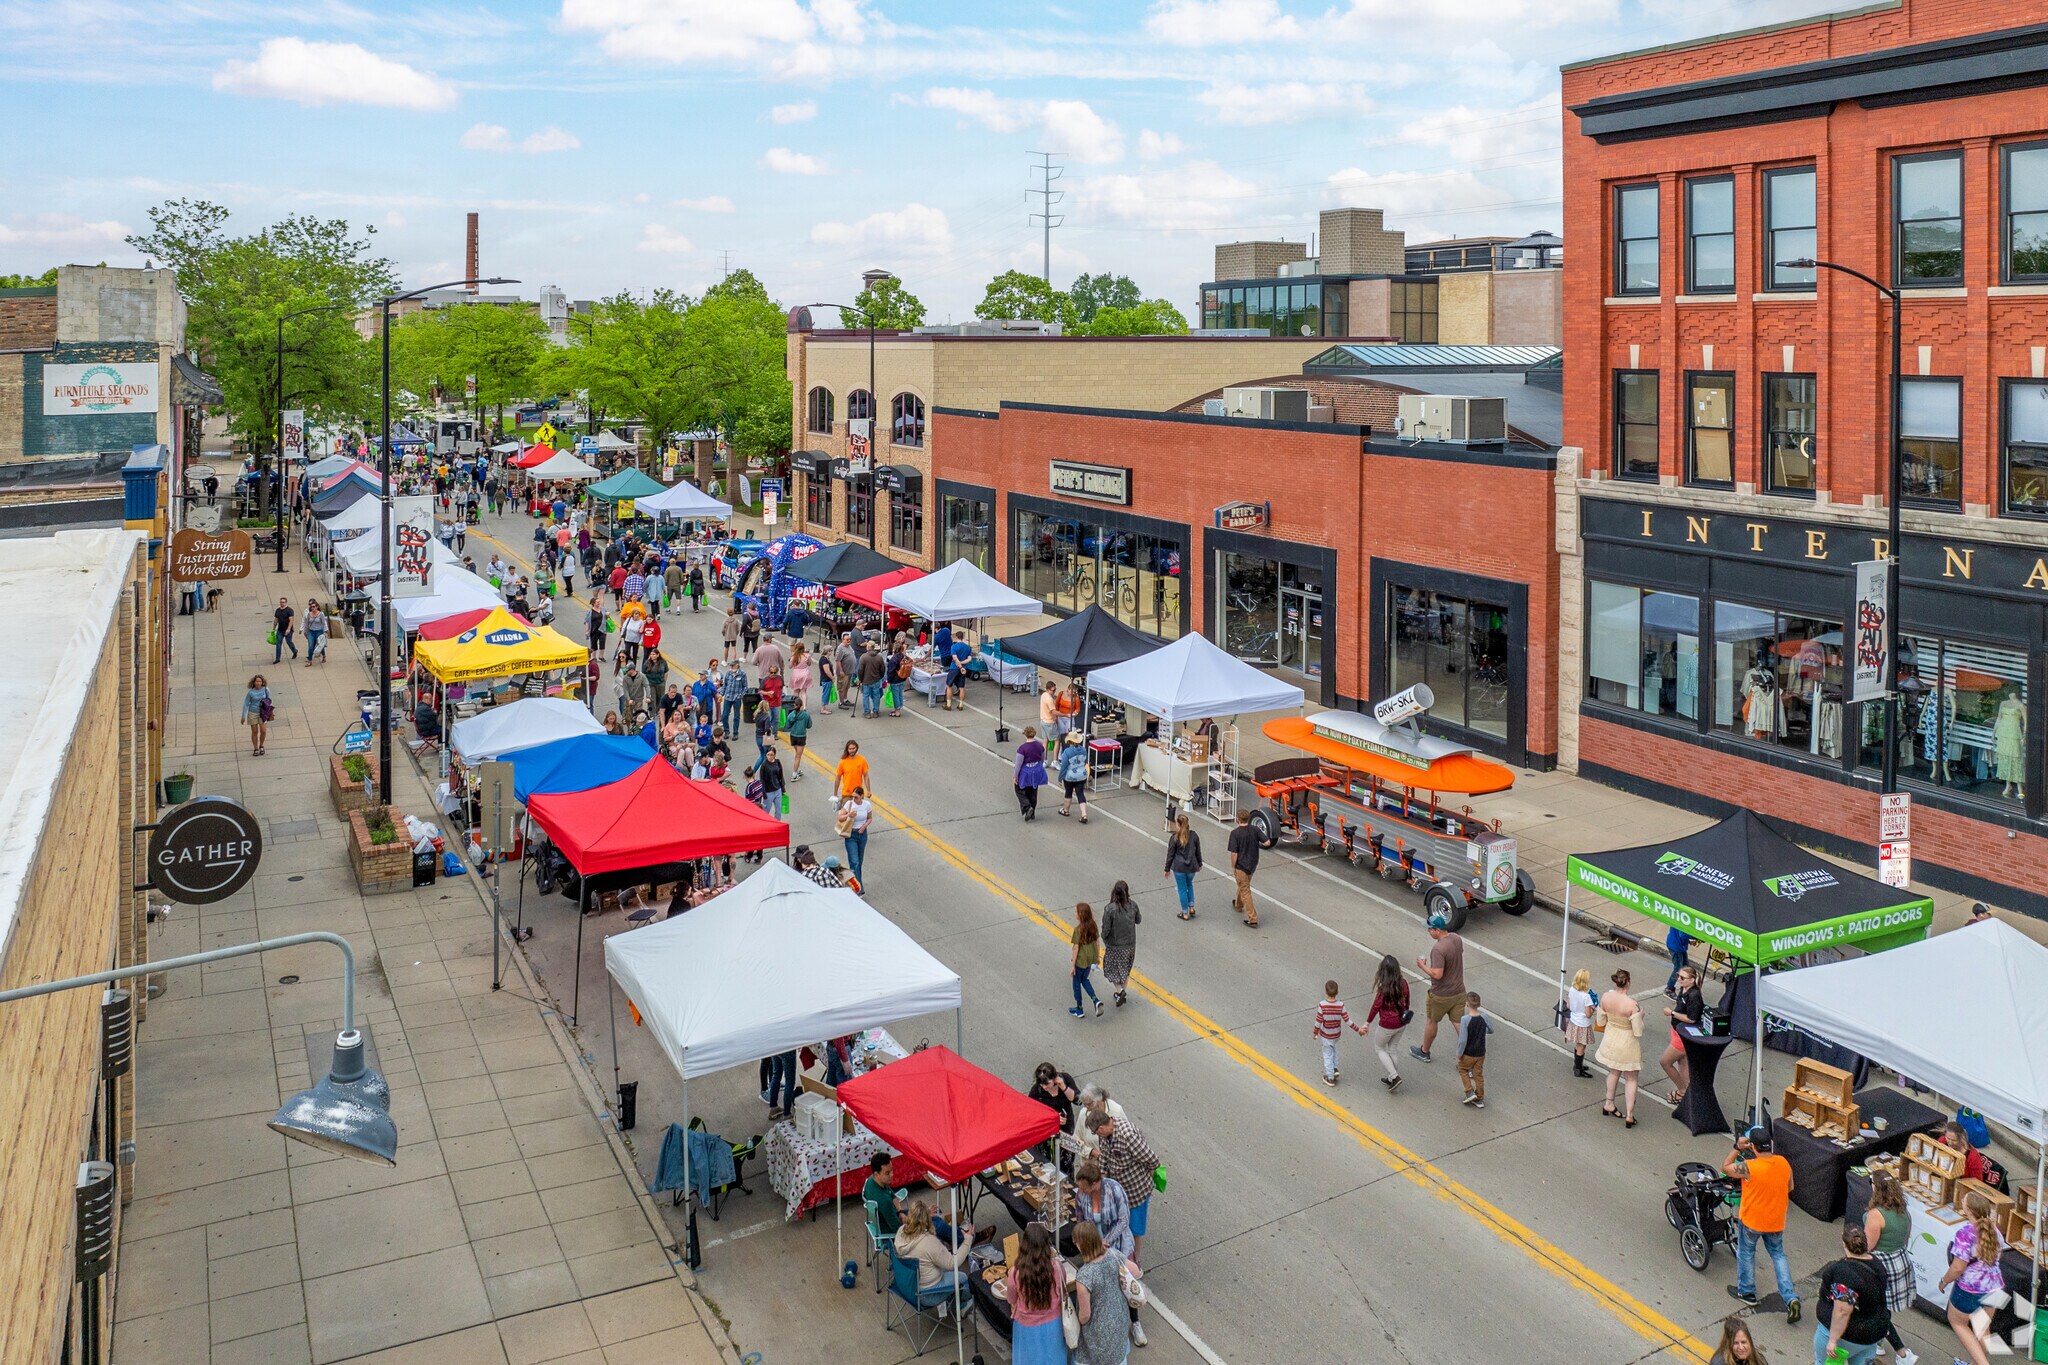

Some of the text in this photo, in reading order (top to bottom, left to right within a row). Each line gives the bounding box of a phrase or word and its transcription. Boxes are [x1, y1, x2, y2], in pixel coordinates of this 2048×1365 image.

[54, 383, 149, 397] FURNITURE SECONDS
[583, 438, 591, 448] P
[1231, 506, 1255, 517] PETE'S
[1229, 516, 1256, 527] GARAGE
[191, 539, 231, 553] String
[176, 550, 247, 564] Instrument
[179, 561, 243, 576] Workshop
[454, 669, 470, 678] CAFE
[475, 662, 506, 676] ESPRESSO
[511, 660, 533, 670] COFFEE
[554, 656, 578, 664] BAKERY
[1856, 670, 1876, 681] DISTRICT
[1377, 691, 1414, 718] BRW-SKI
[1315, 724, 1329, 736] BOOK
[1329, 729, 1342, 740] NOW
[1890, 797, 1901, 806] NO
[1882, 806, 1908, 817] PARKING
[1884, 816, 1898, 824] HERE
[1884, 823, 1906, 832] CORNER
[158, 840, 253, 866] GATHER
[1881, 850, 1891, 858] NO
[1696, 863, 1735, 883] RENEWAL
[1698, 872, 1731, 887] ANDERSEN
[1795, 869, 1830, 882] RENEWAL
[1805, 874, 1835, 885] ANDERSEN
[1885, 876, 1904, 886] TODAY
[1579, 867, 1743, 949] WINDOWS & PATIO DOORS
[1770, 907, 1923, 952] WINDOWS & PATIO DOORS
